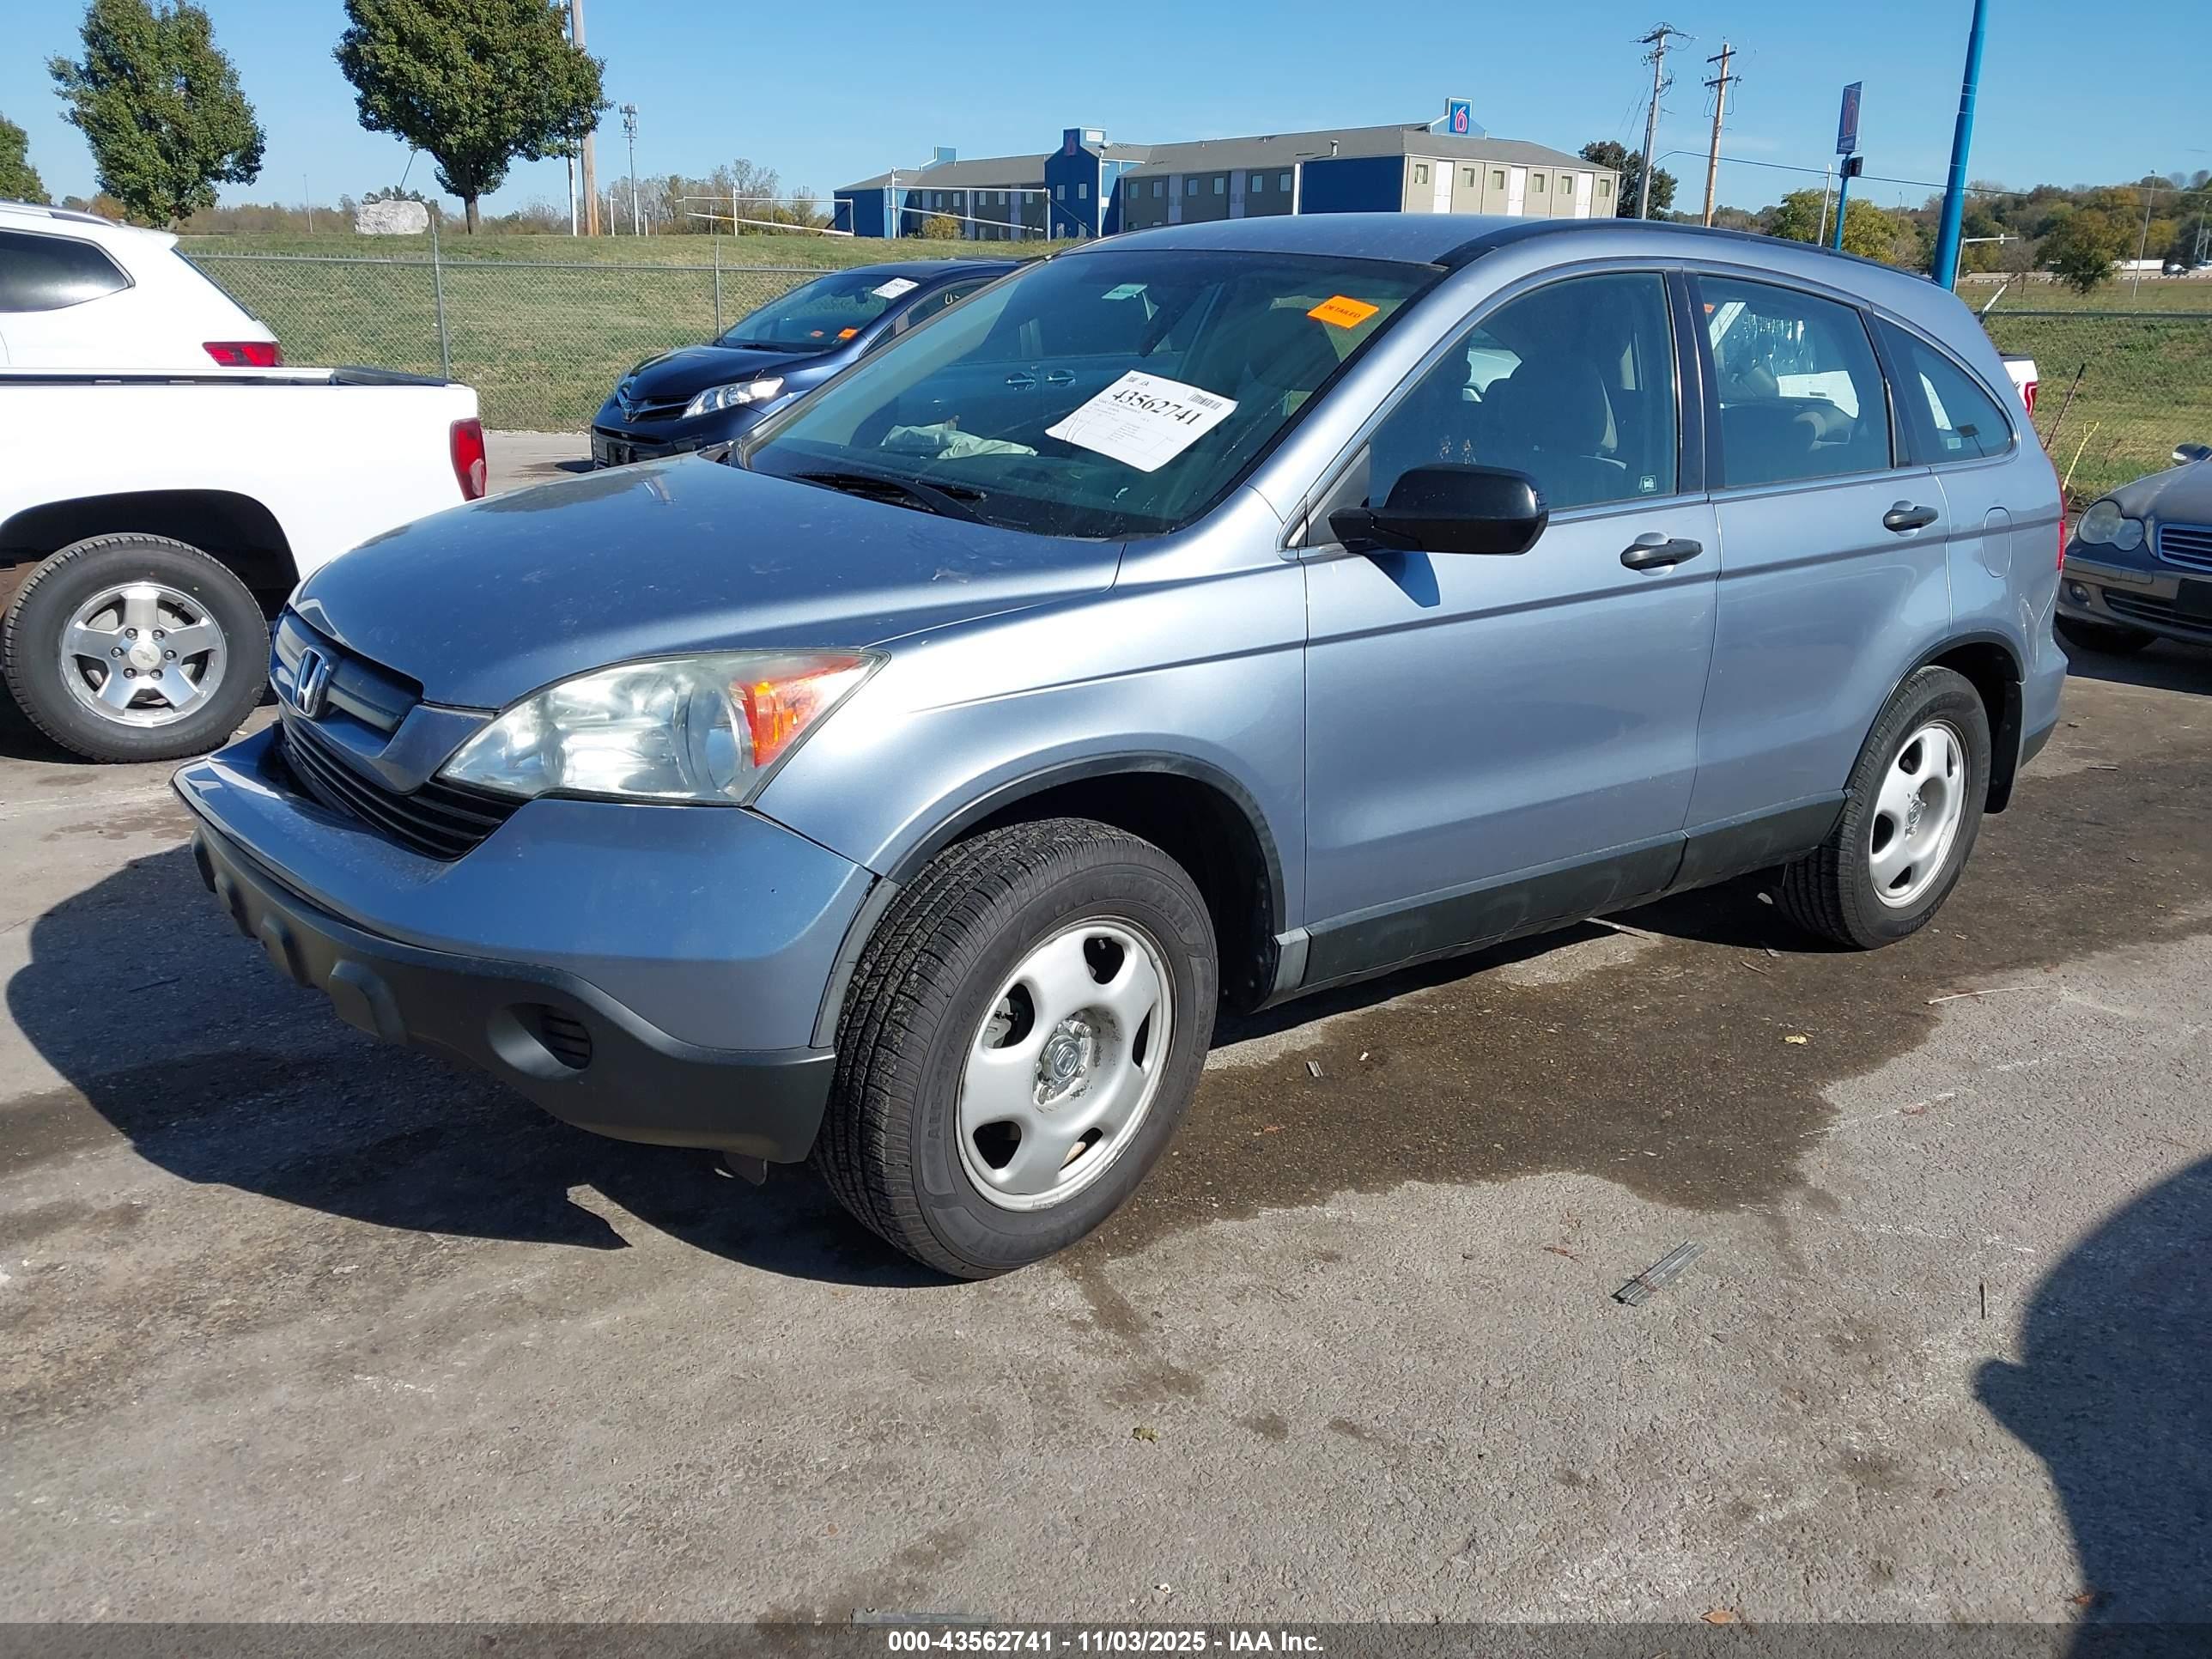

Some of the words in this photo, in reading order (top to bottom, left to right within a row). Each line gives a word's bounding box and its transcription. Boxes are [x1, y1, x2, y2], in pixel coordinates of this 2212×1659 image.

[1455, 106, 1468, 133] 6
[1324, 304, 1361, 319] DETAILED
[1112, 388, 1204, 426] 43562741
